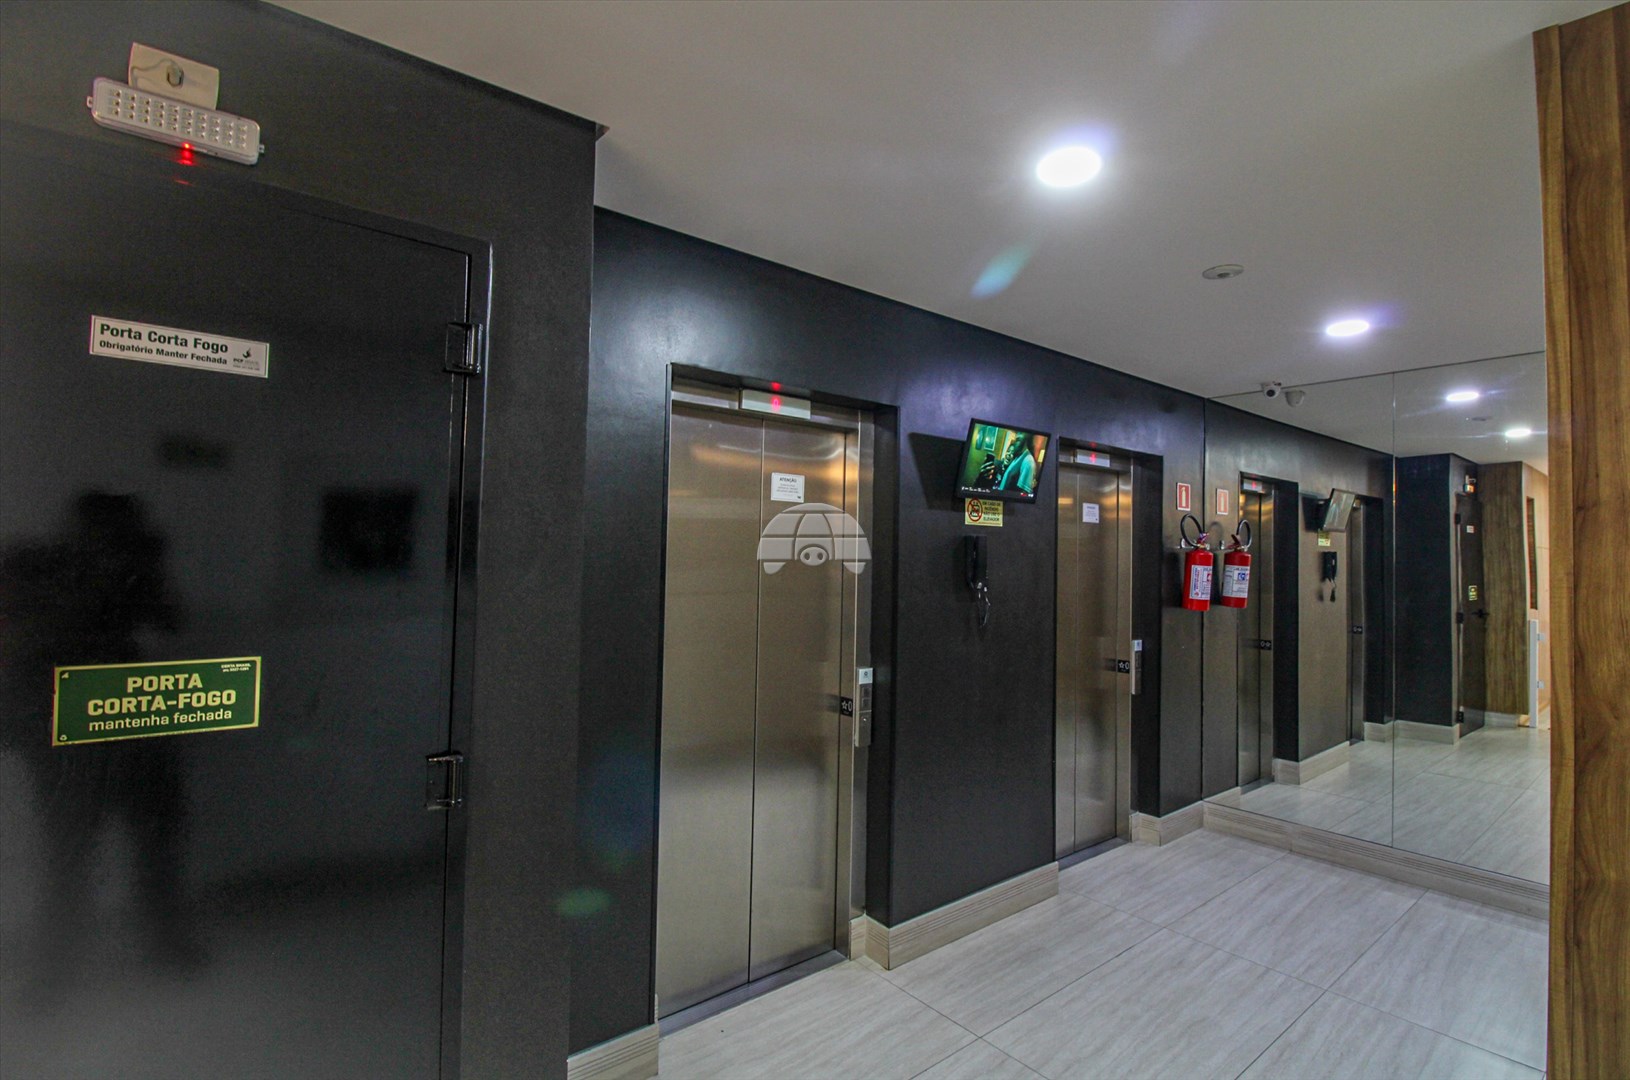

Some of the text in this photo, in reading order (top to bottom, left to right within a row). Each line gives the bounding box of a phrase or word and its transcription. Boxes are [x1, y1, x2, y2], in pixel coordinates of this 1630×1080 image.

[100, 323, 229, 354] Porta Corta Fogo
[99, 340, 228, 365] Obrigatório Manter Fechada
[126, 672, 203, 694] PORTA
[87, 689, 237, 716] CORTA-FOGO
[88, 708, 232, 732] mantenha fechada
